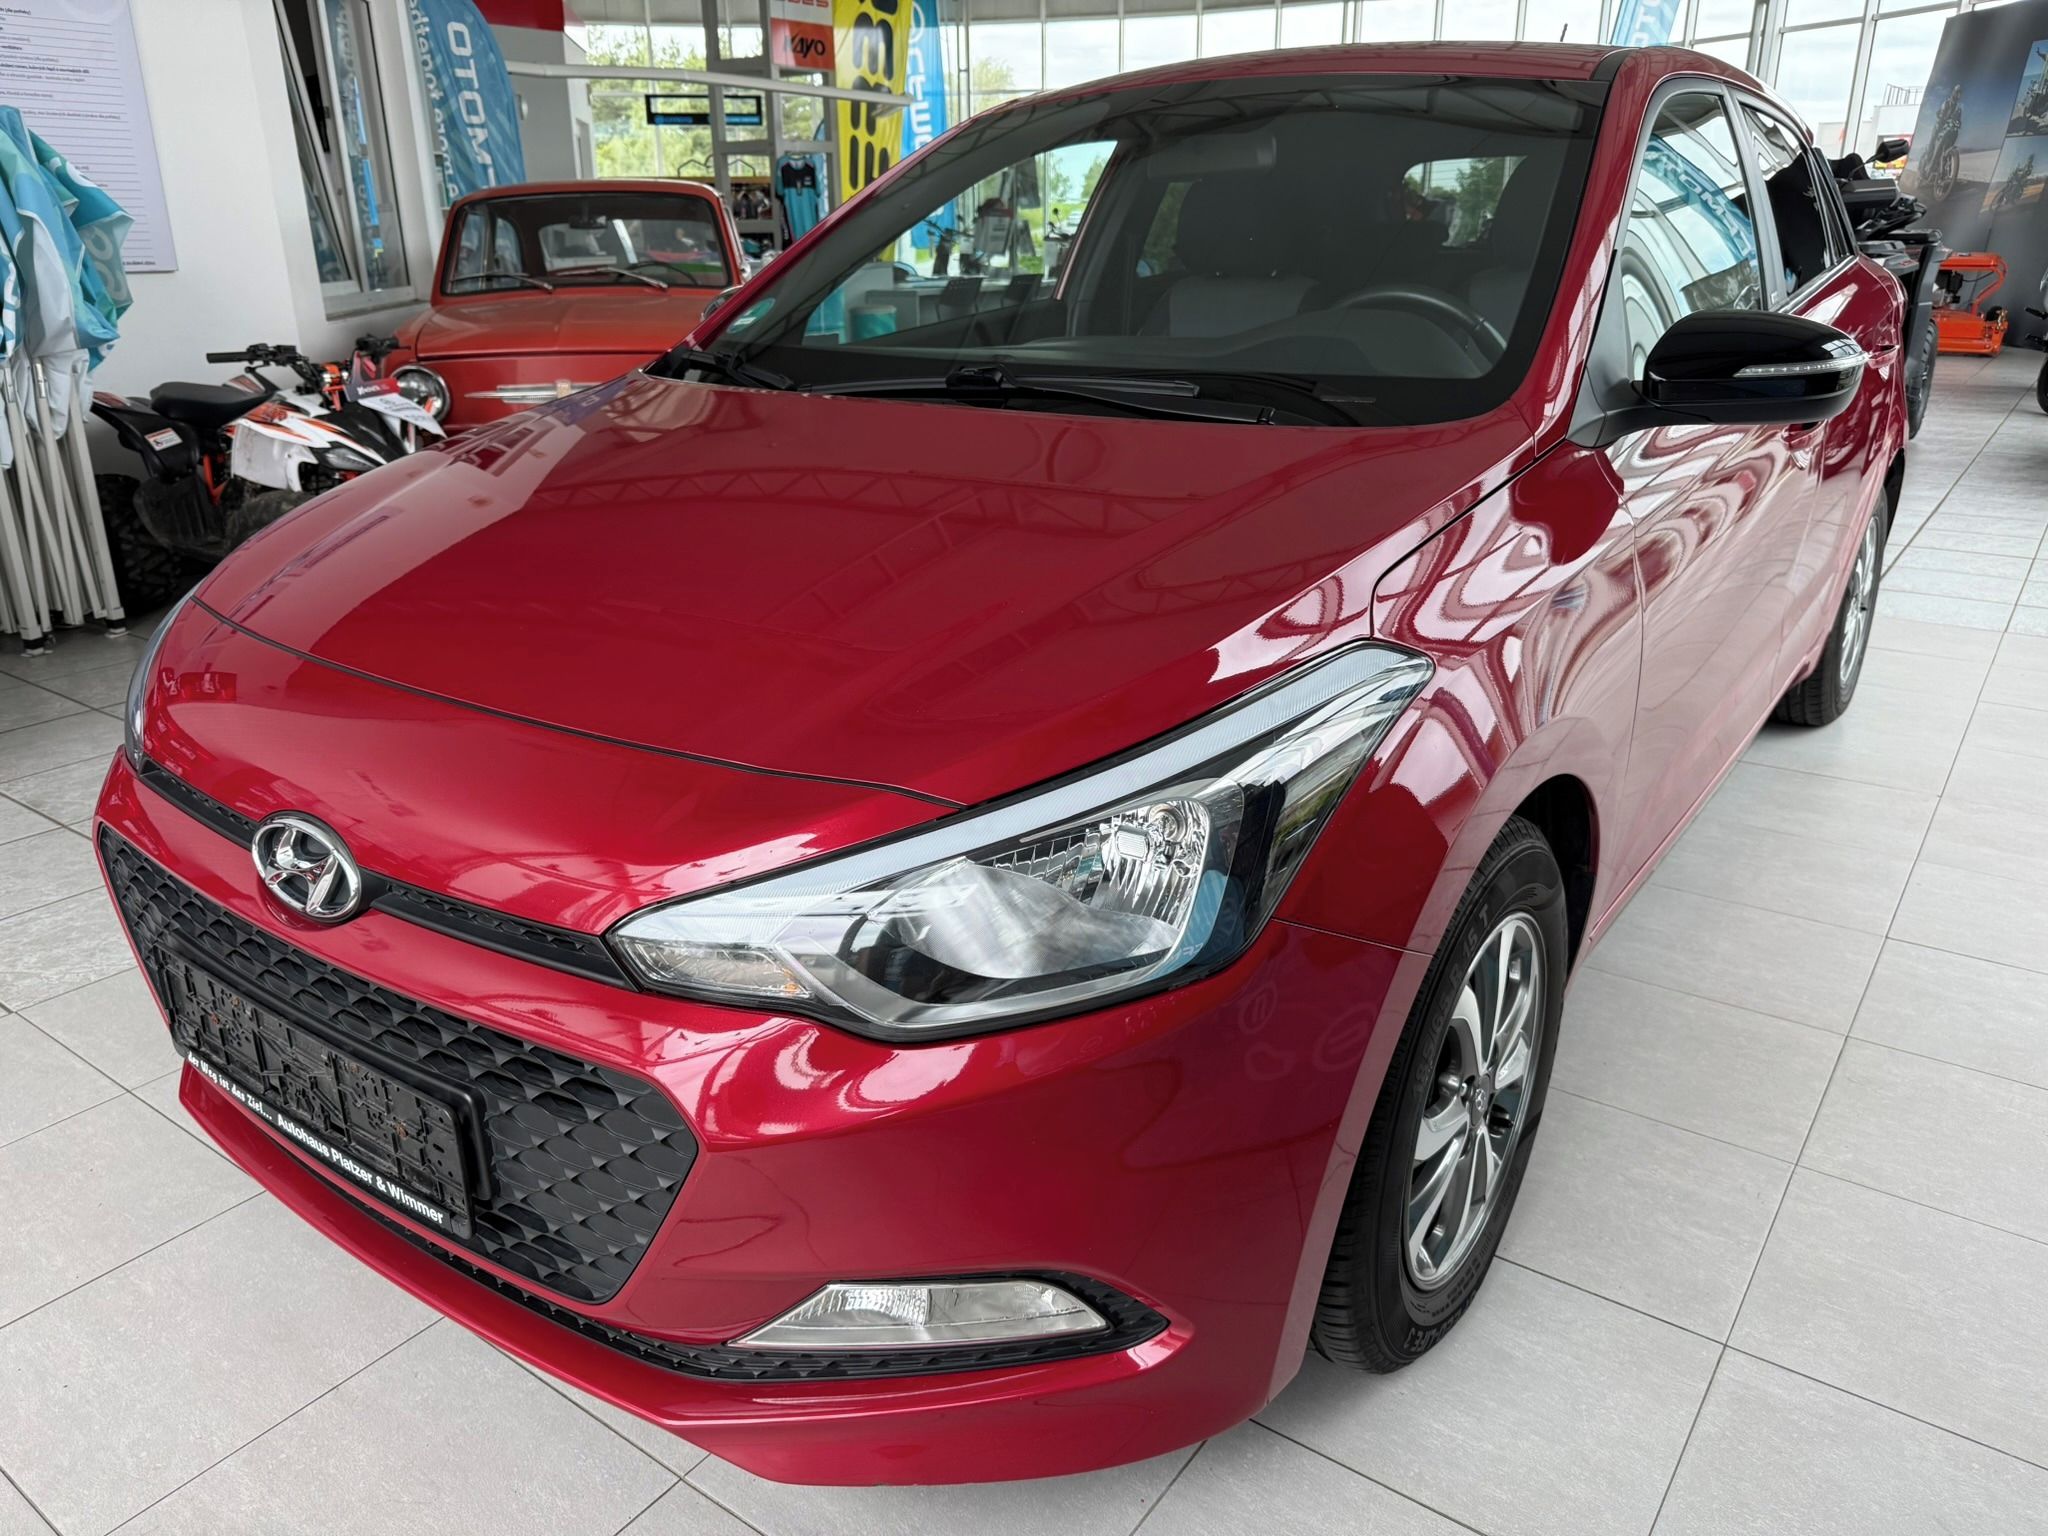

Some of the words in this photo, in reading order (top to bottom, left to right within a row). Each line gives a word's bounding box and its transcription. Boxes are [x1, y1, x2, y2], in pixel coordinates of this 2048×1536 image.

[277, 1113, 330, 1158] Autohaus
[331, 1149, 374, 1184] Platzer
[375, 1175, 387, 1193] &
[387, 1181, 444, 1224] Wimmer
